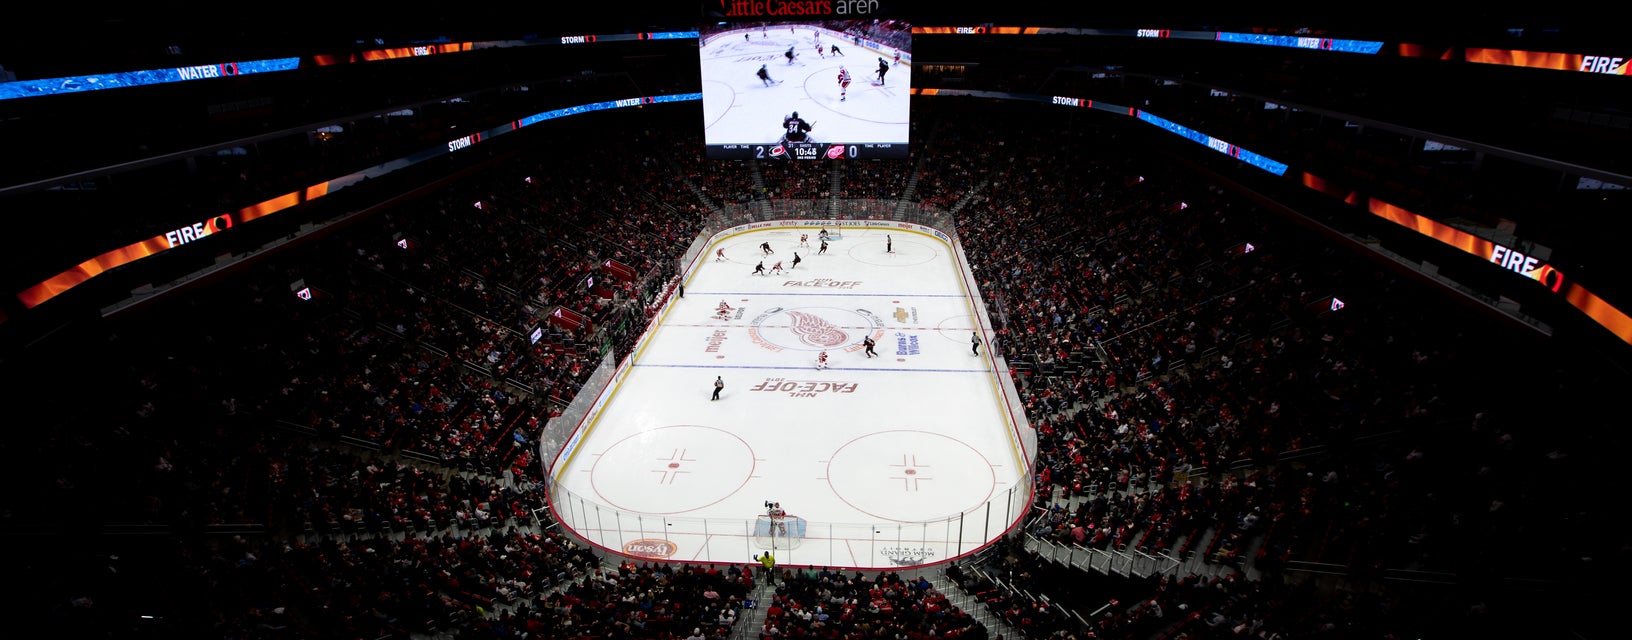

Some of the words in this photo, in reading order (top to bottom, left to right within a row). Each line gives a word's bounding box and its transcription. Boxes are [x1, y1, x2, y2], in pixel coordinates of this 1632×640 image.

[766, 0, 832, 16] Caesars
[836, 0, 879, 14] aren
[561, 35, 585, 44] STORM
[1137, 29, 1159, 38] STORM
[1297, 37, 1320, 50] WATER
[414, 46, 428, 56] FIRE
[1580, 55, 1623, 75] FIRE
[177, 64, 219, 81] WATER
[616, 96, 640, 108] WATER
[1052, 95, 1079, 107] STORM
[788, 124, 798, 134] 34
[448, 135, 471, 152] STORM
[1208, 135, 1229, 154] WATER
[756, 146, 764, 159] 2
[849, 145, 857, 158] 0
[166, 222, 205, 248] FIRE
[1490, 245, 1538, 276] FIRE
[705, 330, 728, 353] meijer
[895, 338, 908, 355] Burns
[749, 381, 859, 393] FACE-OFF
[627, 543, 668, 556] Tyson
